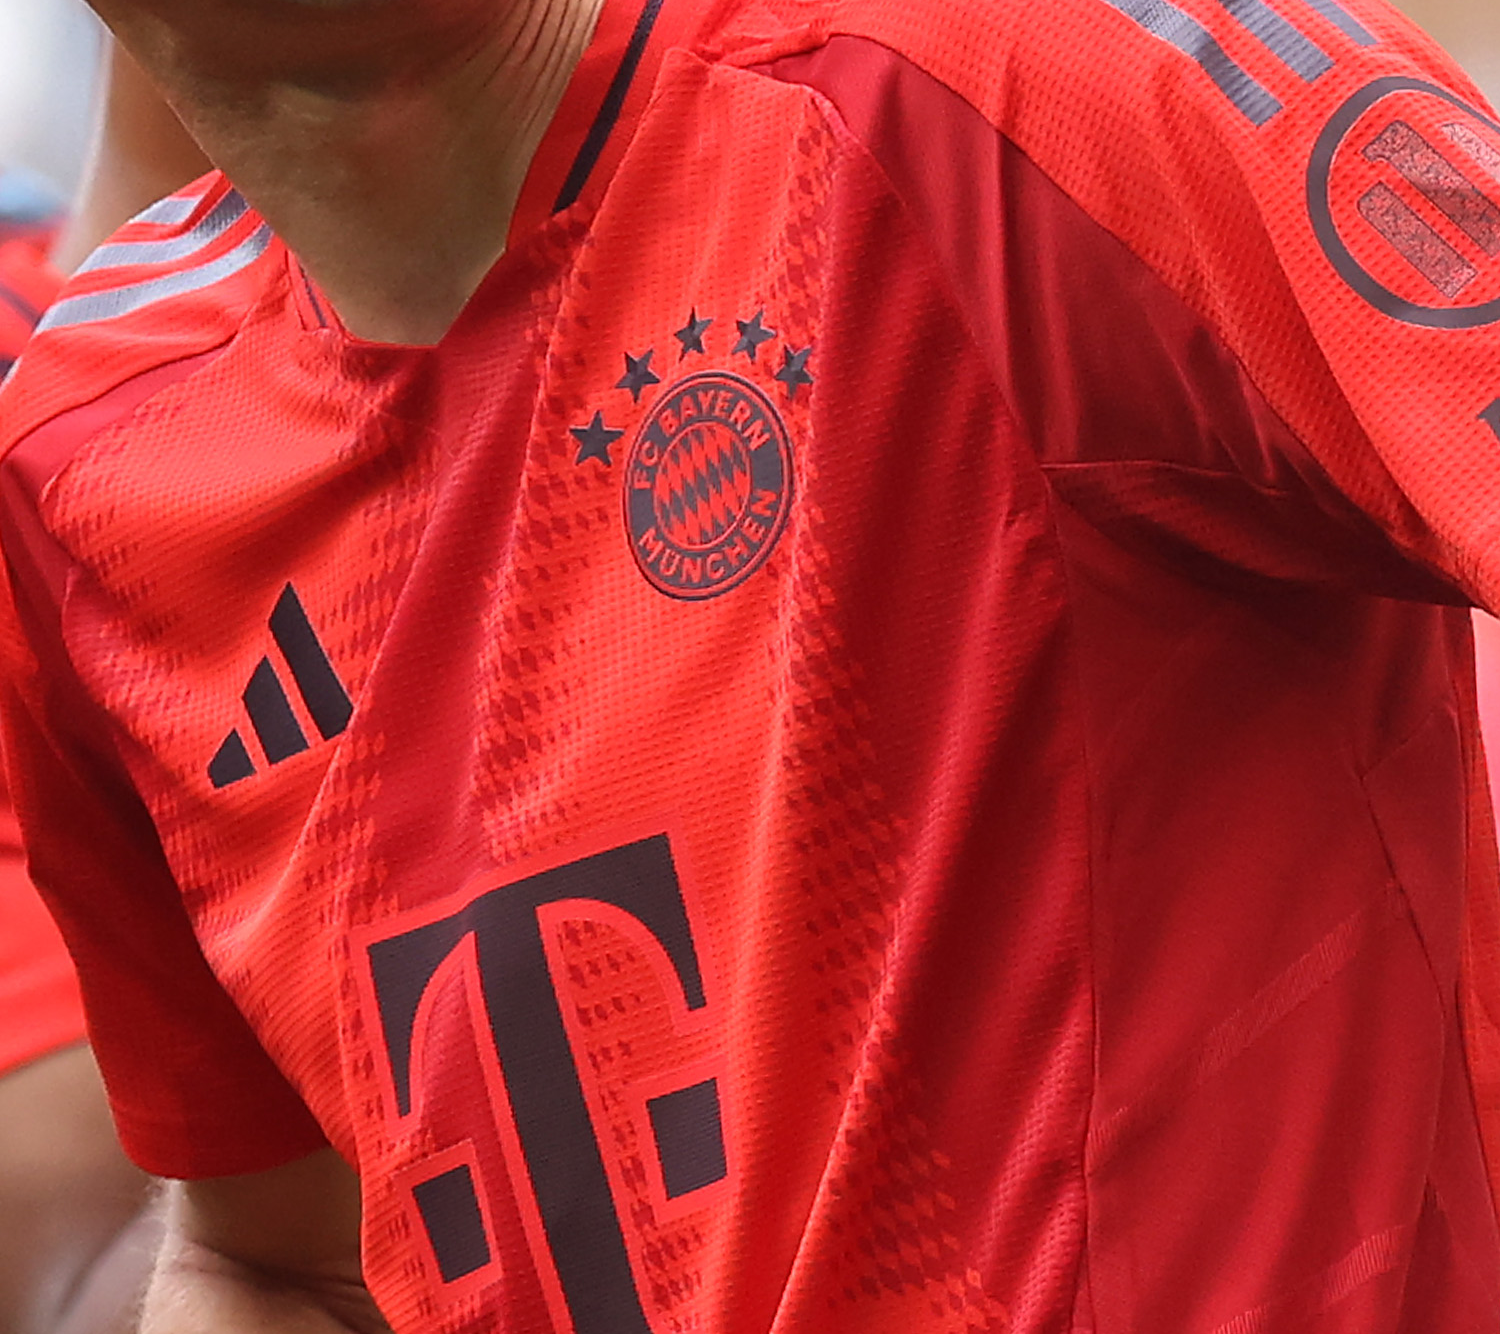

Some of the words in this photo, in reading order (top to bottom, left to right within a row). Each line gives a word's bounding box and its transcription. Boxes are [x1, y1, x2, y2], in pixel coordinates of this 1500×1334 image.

[633, 440, 659, 490] FC
[659, 389, 771, 451] BAYERN
[638, 488, 778, 585] MÜNCHEN
